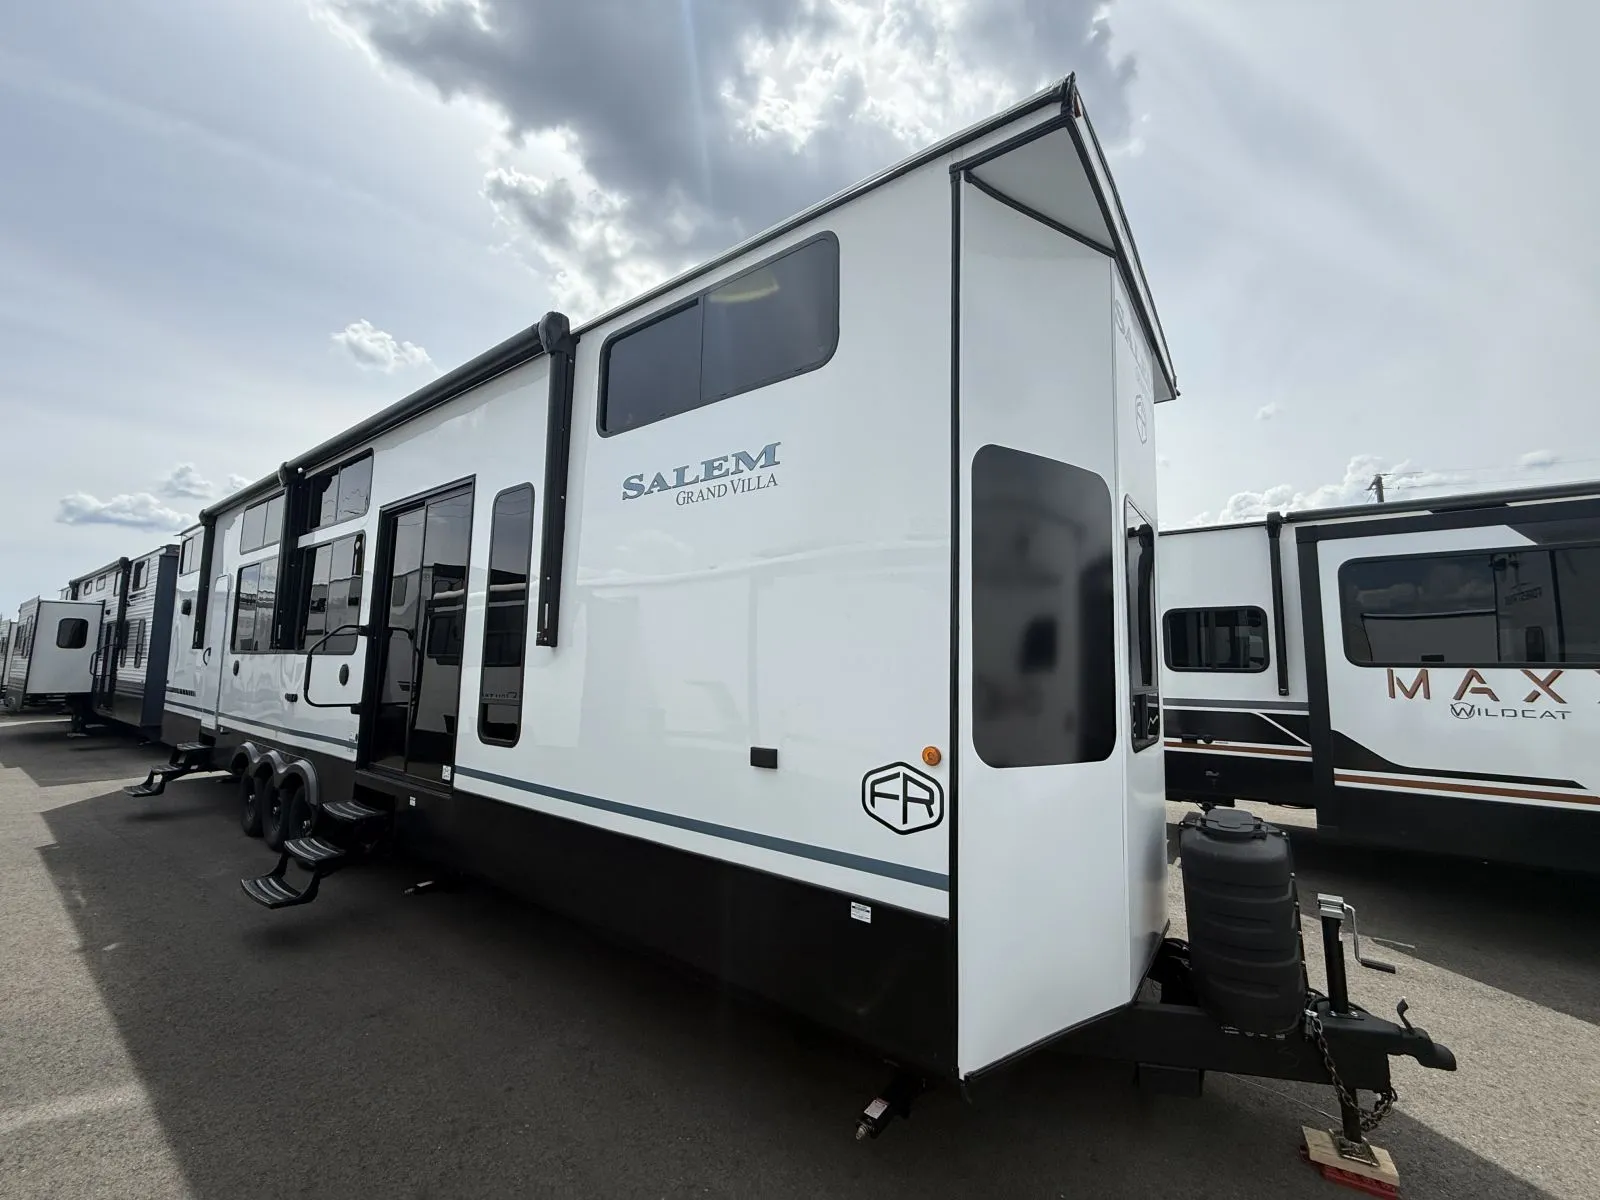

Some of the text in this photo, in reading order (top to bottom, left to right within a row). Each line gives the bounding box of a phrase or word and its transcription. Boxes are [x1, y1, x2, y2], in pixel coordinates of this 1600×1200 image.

[622, 441, 781, 500] SALEM
[676, 472, 778, 506] GRAND VILLA
[1387, 668, 1600, 704] MAX
[1450, 702, 1572, 719] WILDCAT
